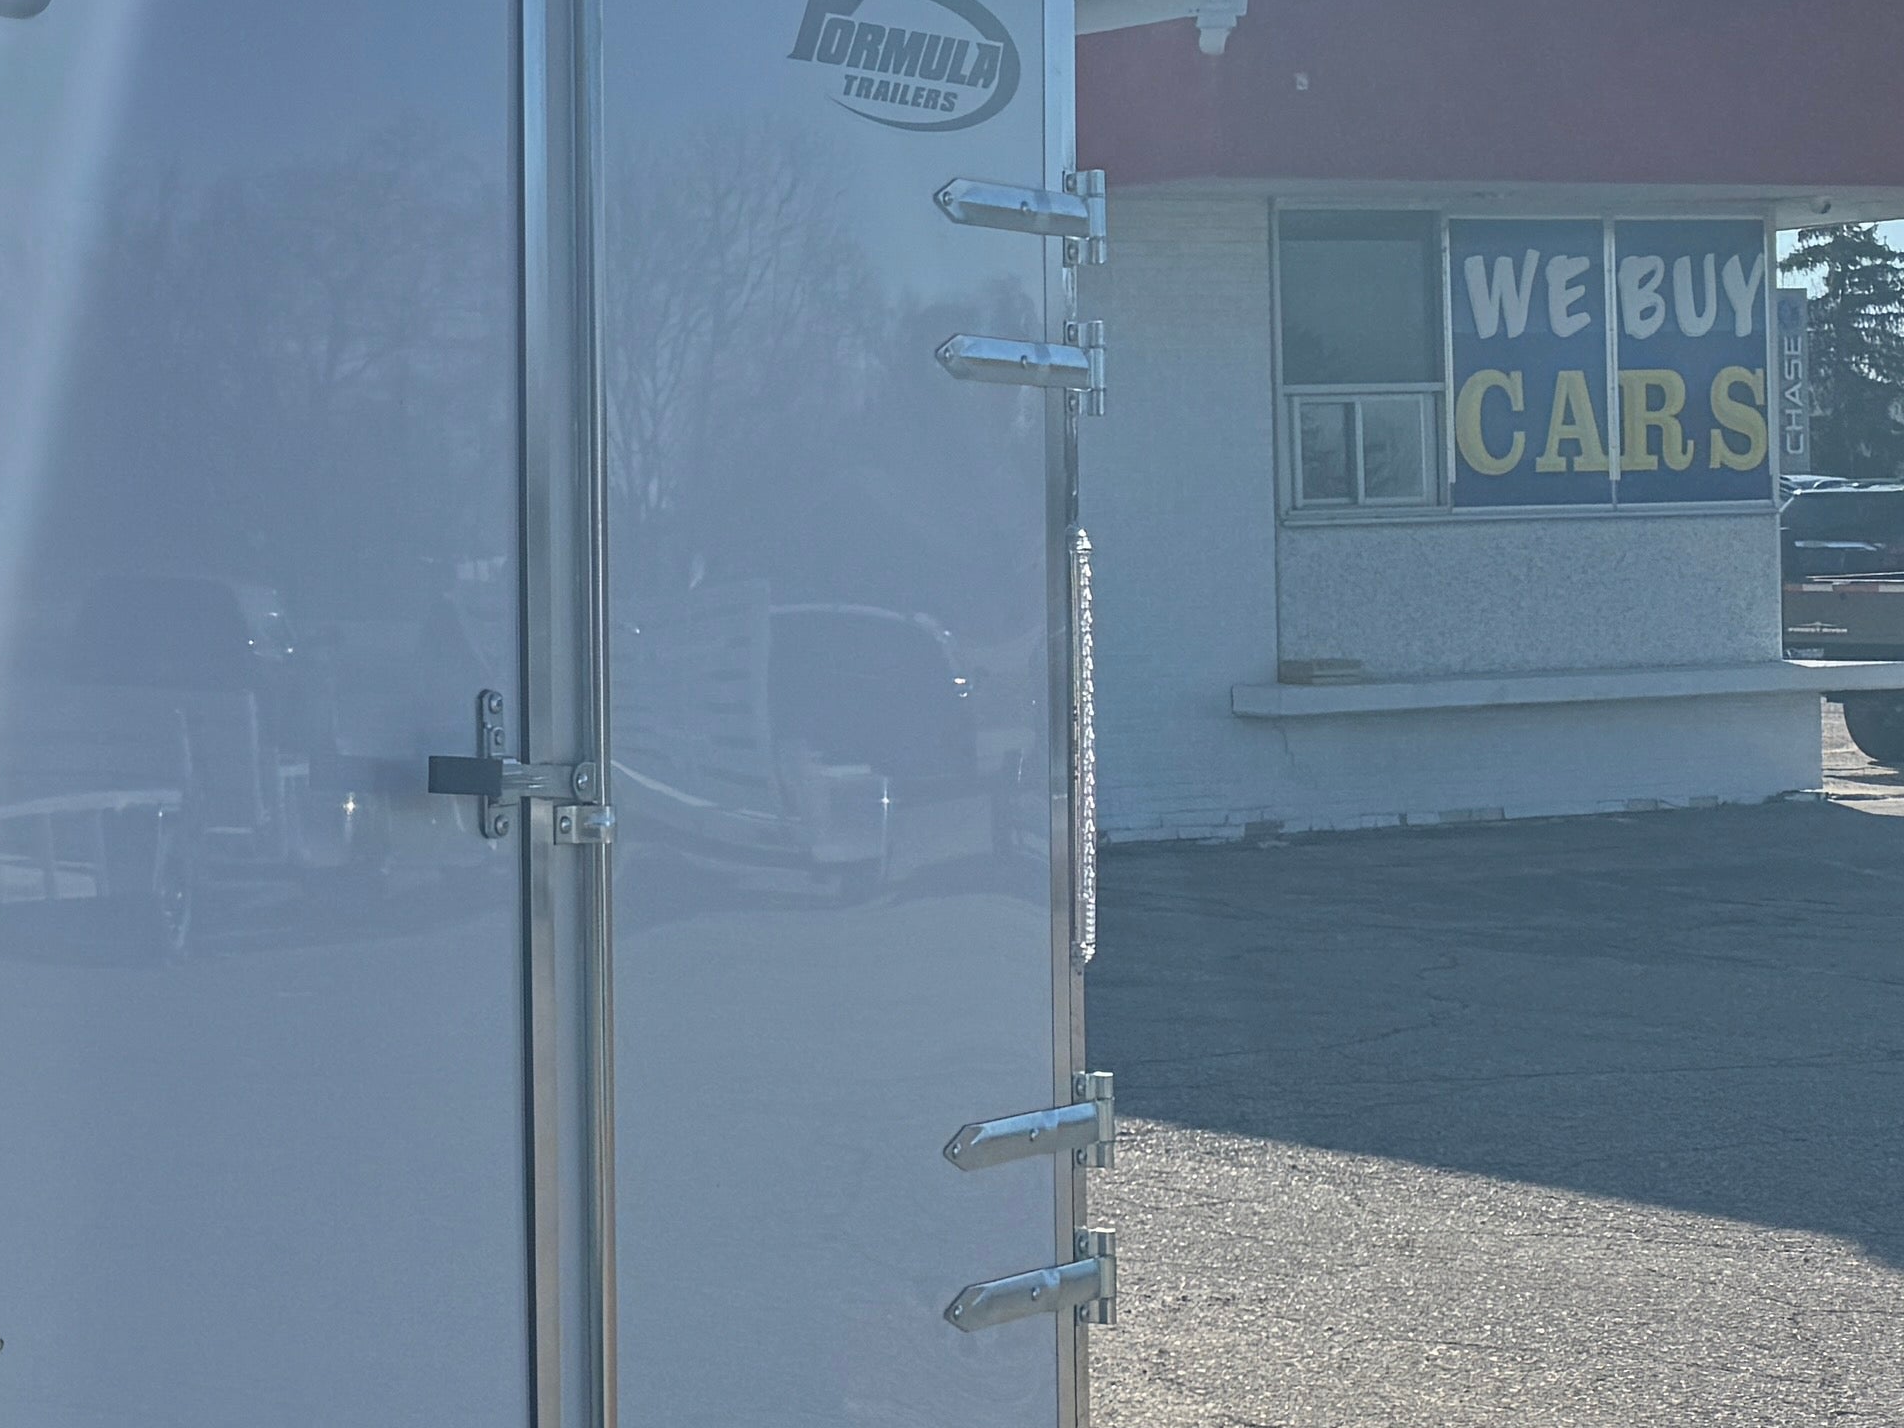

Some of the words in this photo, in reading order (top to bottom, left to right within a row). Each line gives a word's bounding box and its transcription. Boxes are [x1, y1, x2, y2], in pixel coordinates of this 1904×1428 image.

[842, 74, 959, 113] TRAILERS
[1464, 249, 1592, 338] WE
[1616, 253, 1764, 338] BUY
[1455, 366, 1769, 475] CARS
[1783, 335, 1805, 455] CHASE
